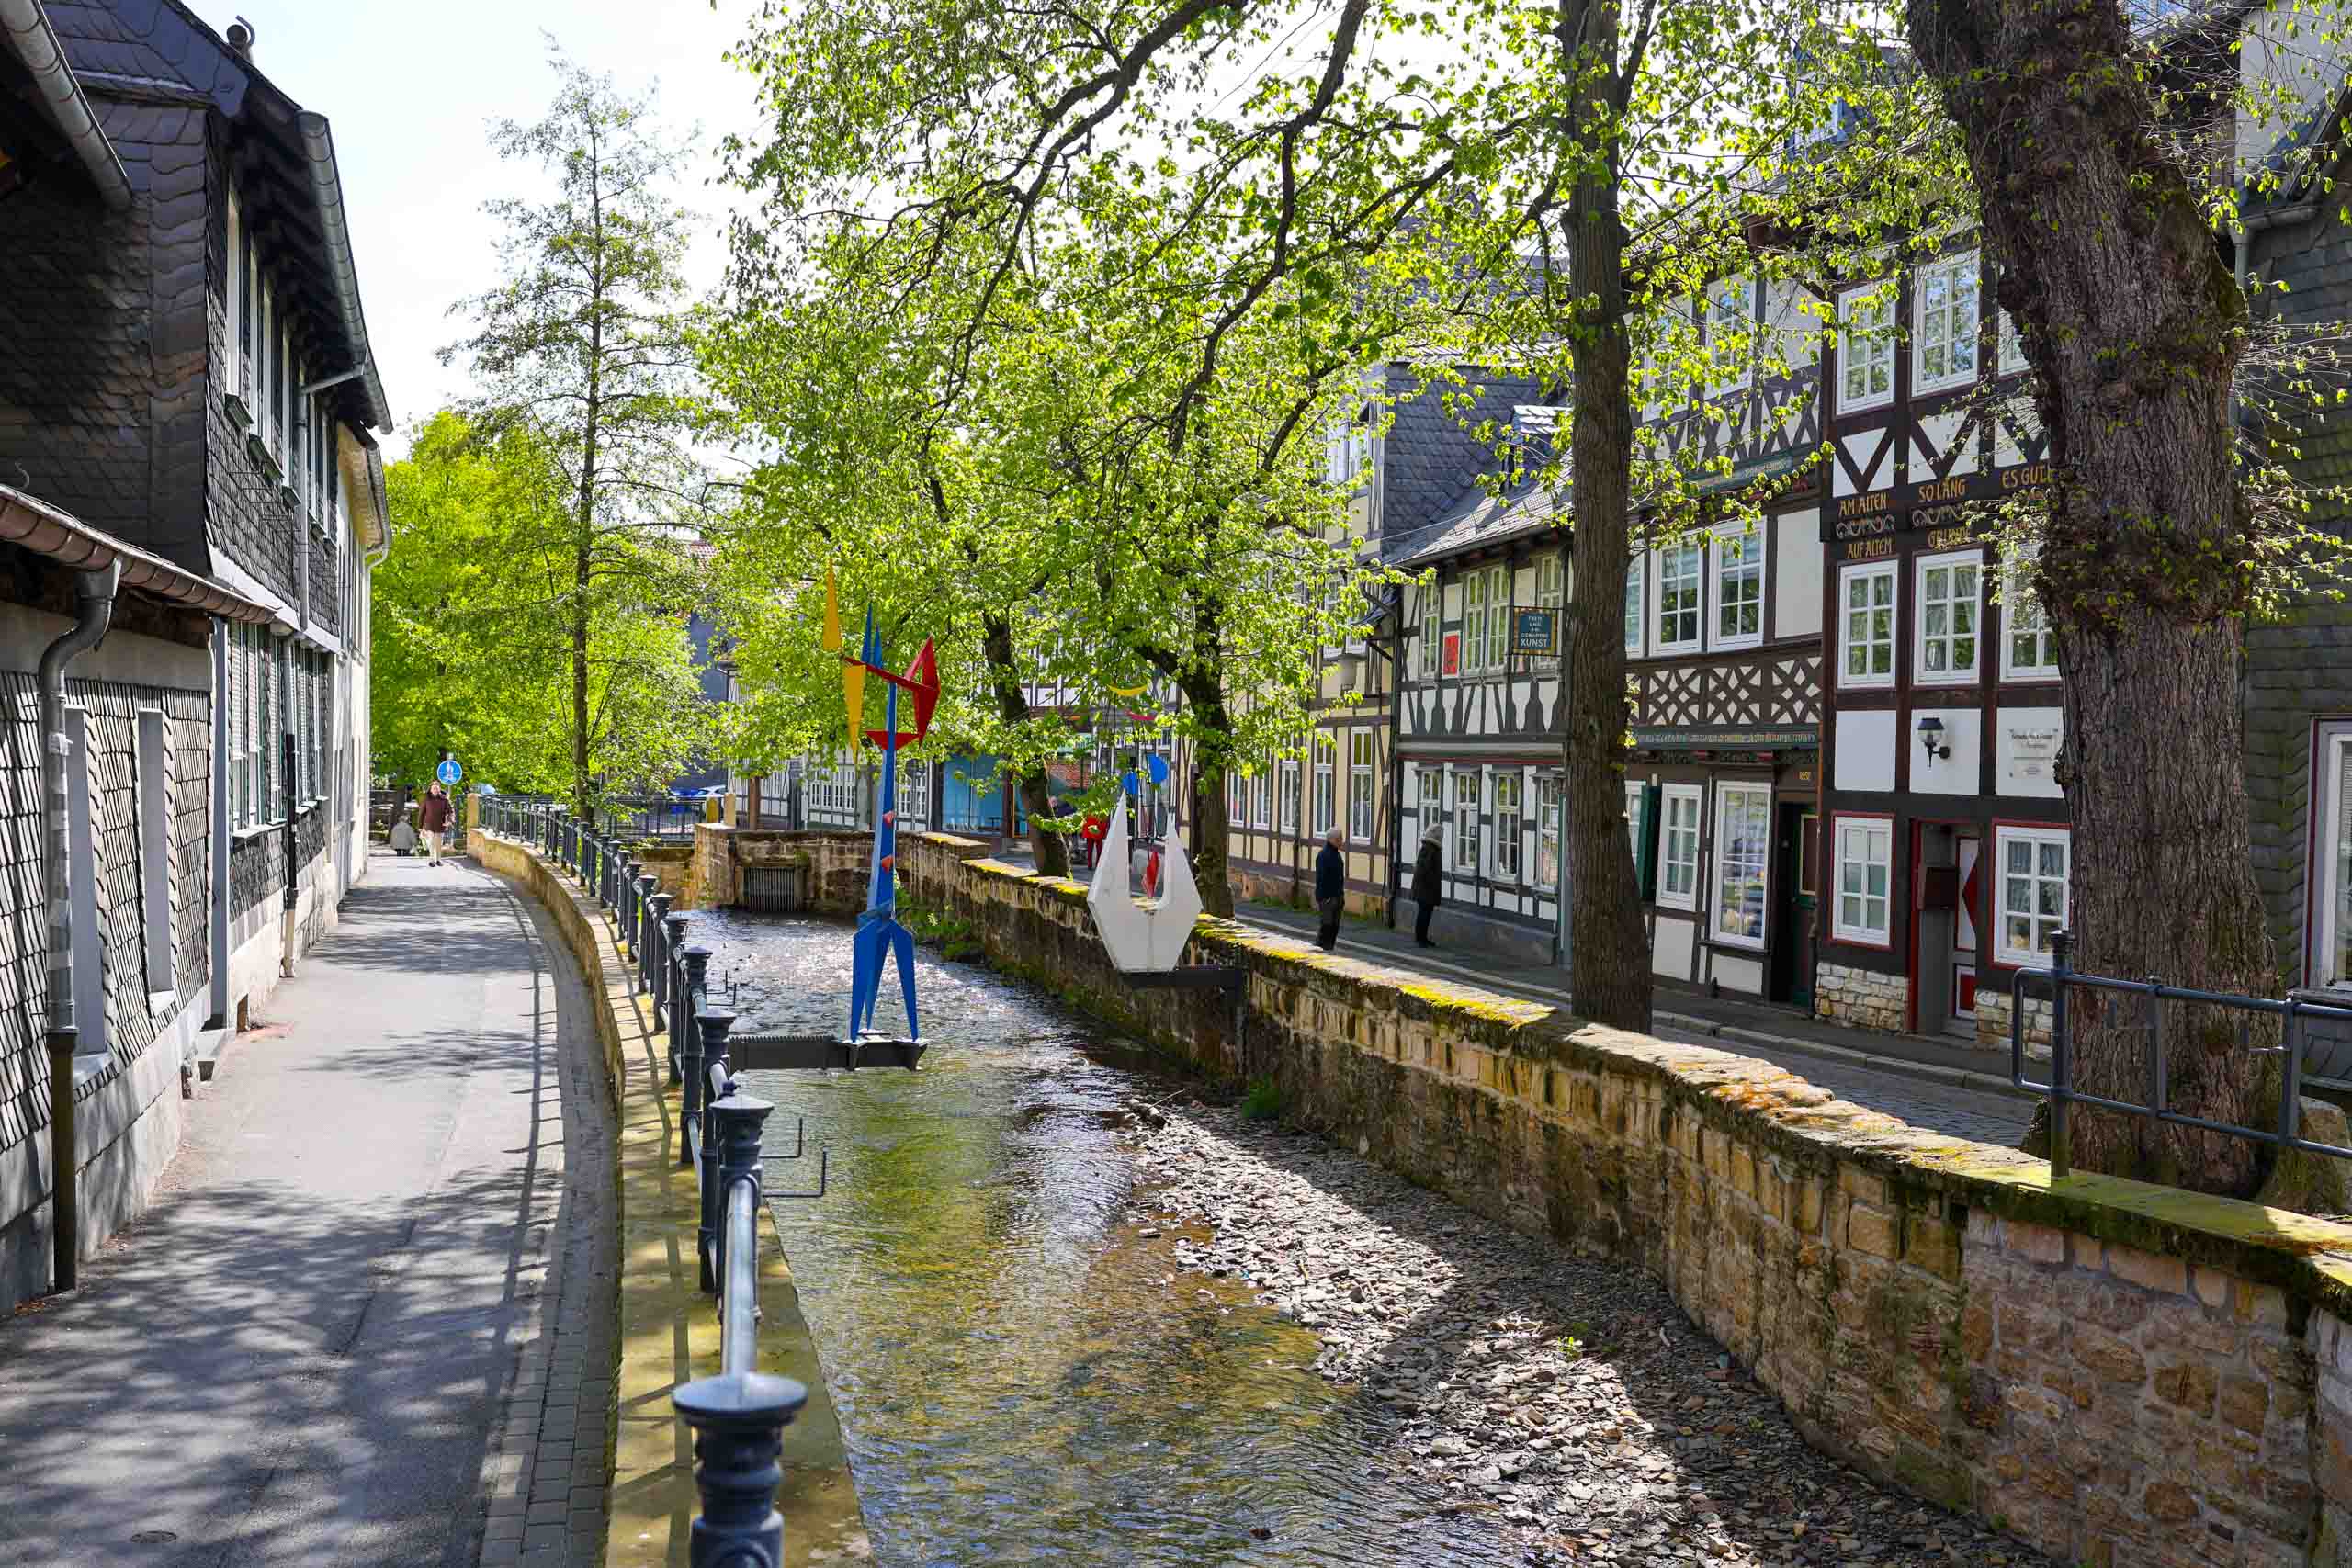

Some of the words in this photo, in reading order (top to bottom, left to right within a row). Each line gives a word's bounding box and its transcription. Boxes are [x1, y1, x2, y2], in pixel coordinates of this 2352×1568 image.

[1839, 499, 1856, 517] AM
[2001, 469, 2018, 489] ES
[1847, 541, 1864, 559] AUF
[1521, 638, 1549, 647] KUNST
